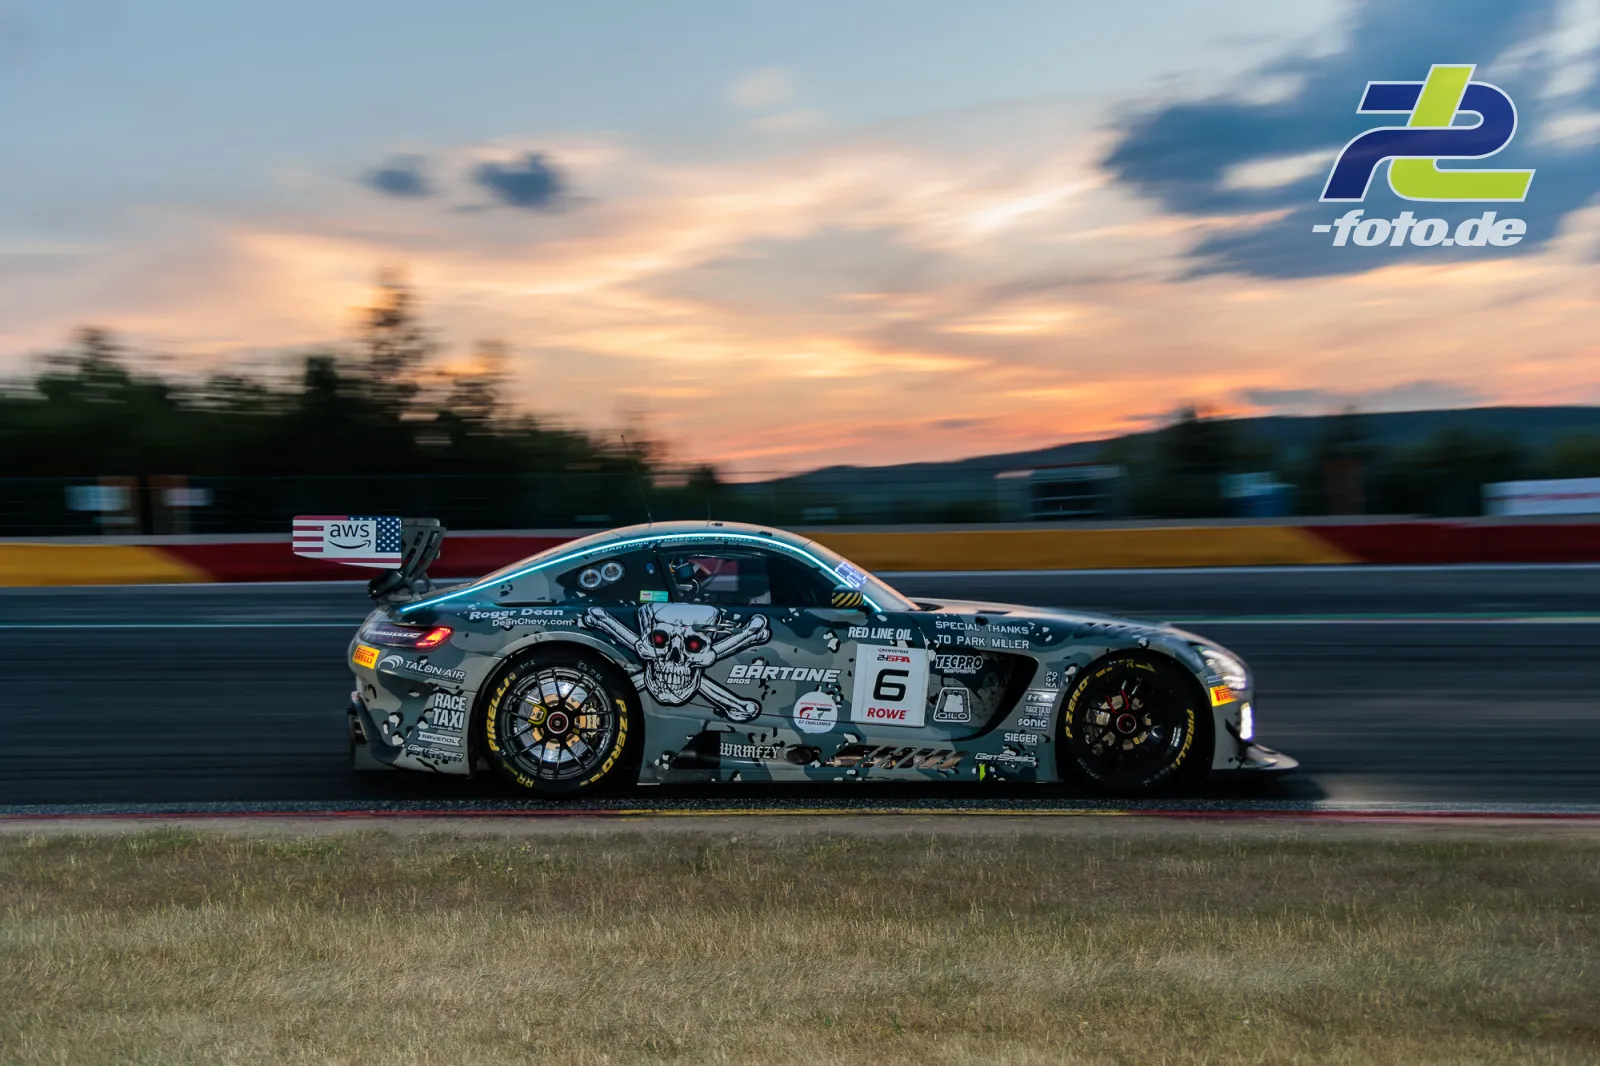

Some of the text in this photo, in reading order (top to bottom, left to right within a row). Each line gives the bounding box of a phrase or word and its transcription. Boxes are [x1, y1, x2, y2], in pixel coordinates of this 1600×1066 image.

[329, 522, 370, 539] aws
[469, 607, 564, 621] Roger Dean
[491, 617, 573, 628] DeanChevy.com
[935, 620, 1030, 635] SPECIAL THANKS
[848, 626, 913, 641] RED LINE OIL
[937, 635, 1030, 650] TO PARK MILLER
[404, 660, 443, 675] TALON
[442, 668, 466, 680] AIR
[935, 654, 984, 670] TECPRO
[729, 664, 841, 683] BARTONE
[872, 668, 910, 702] 6
[434, 692, 467, 711] RACE
[615, 699, 627, 713] P
[1065, 675, 1089, 739] P ZERO
[432, 707, 465, 728] TAXI
[486, 676, 511, 752] PIRELLI
[866, 707, 907, 720] ROWE
[421, 733, 457, 744] RAVENOL
[1004, 732, 1038, 743] SIEGER
[1175, 708, 1195, 767] PIRELLI
[602, 718, 628, 774] ZERO
